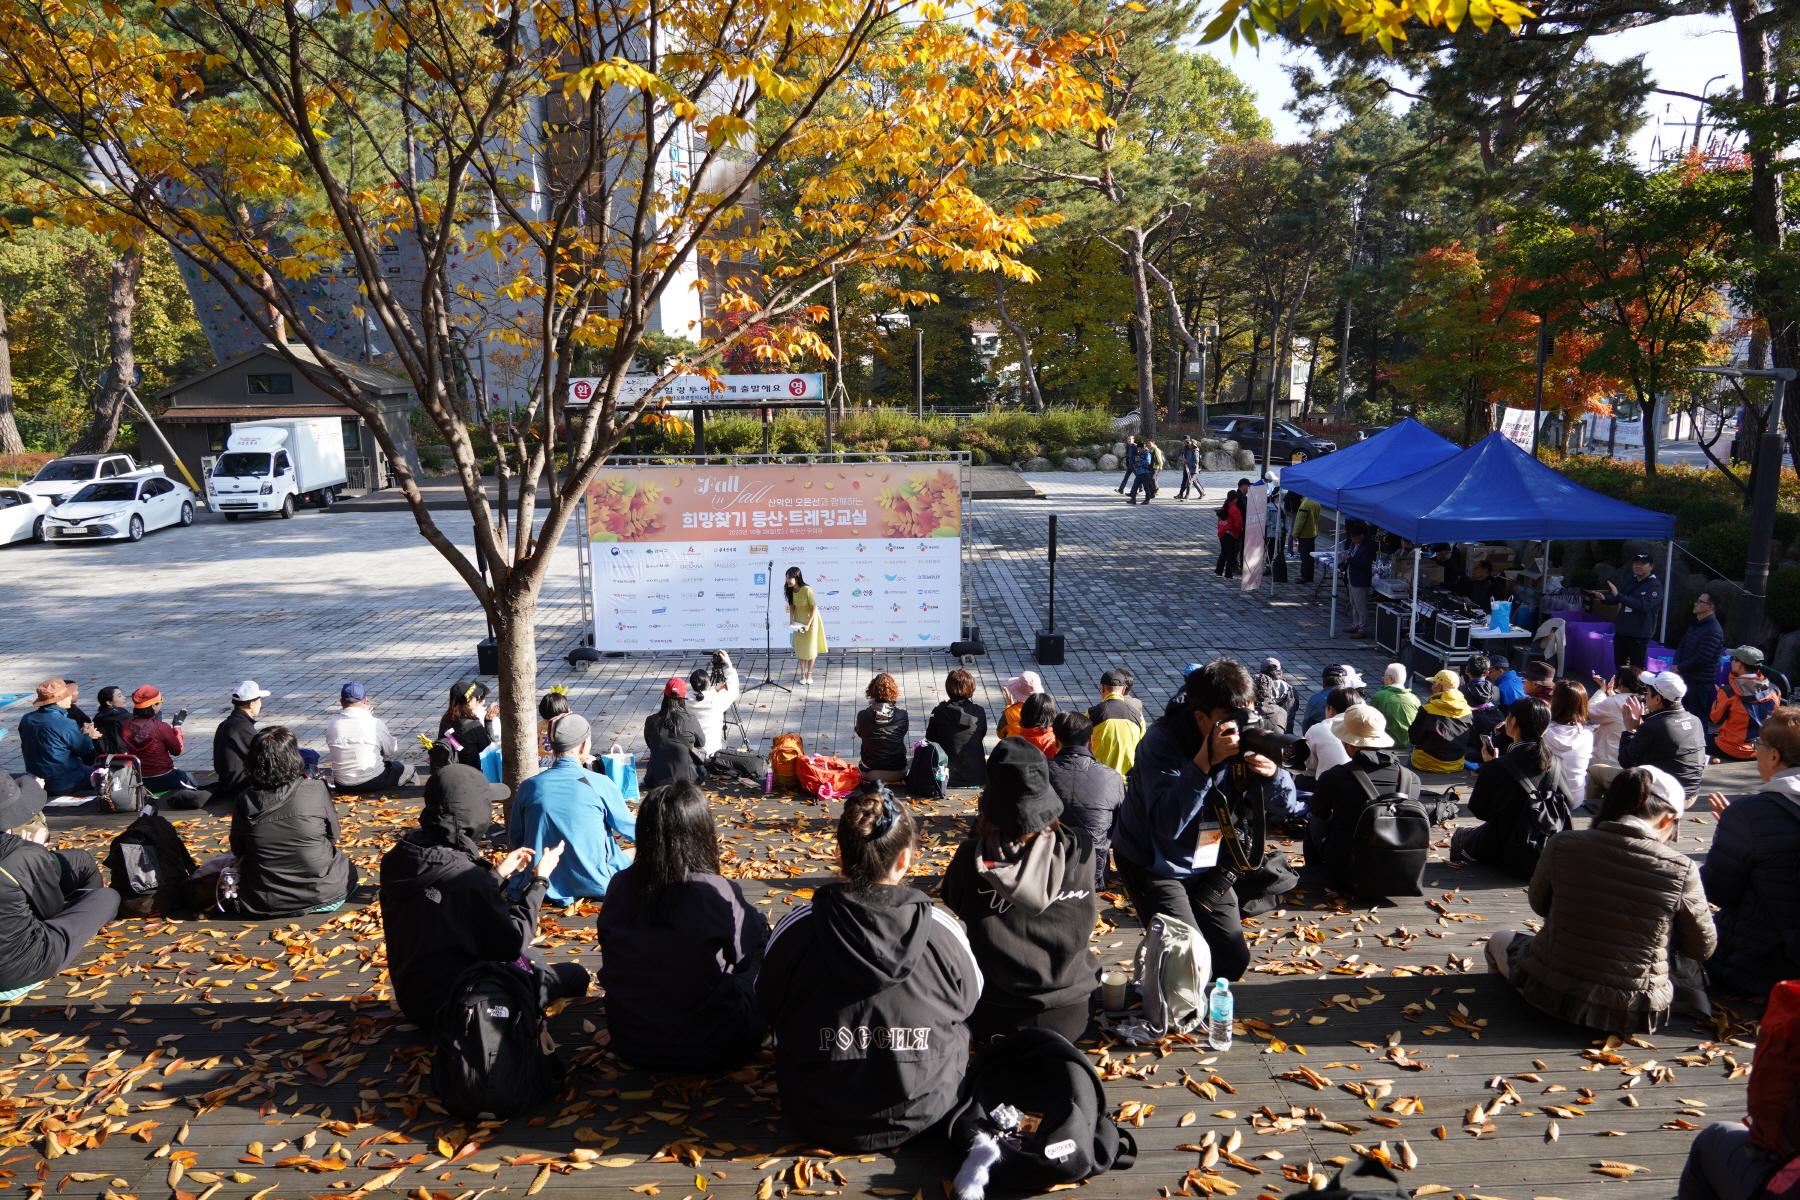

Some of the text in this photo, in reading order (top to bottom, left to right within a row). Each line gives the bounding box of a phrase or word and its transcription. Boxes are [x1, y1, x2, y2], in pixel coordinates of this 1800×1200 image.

[577, 384, 589, 398] 환
[740, 383, 782, 394] 출발해요
[790, 380, 804, 395] 영
[694, 475, 740, 495] Fall
[711, 480, 775, 511] in fall
[767, 496, 864, 508] 산악인 오은선과 함께하는
[682, 509, 868, 529] 희망찾기 등산·트레킹교실
